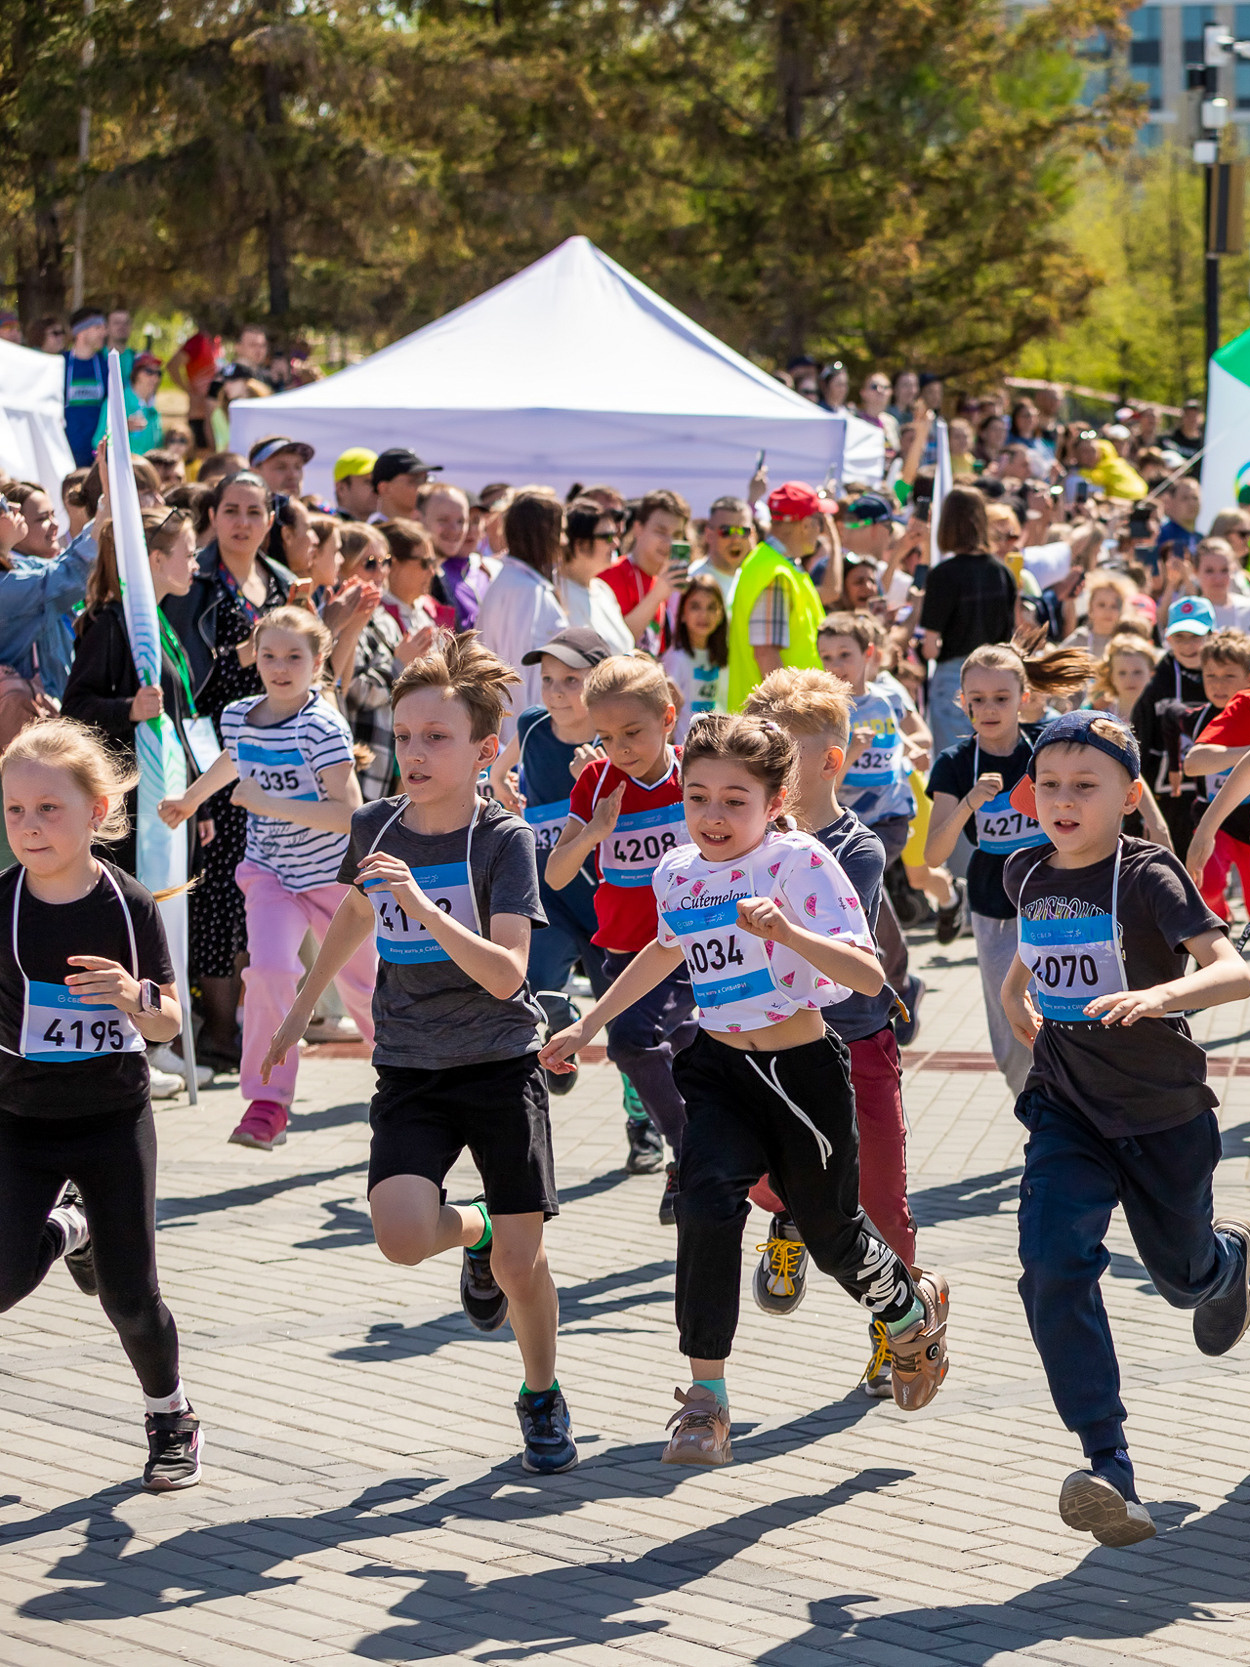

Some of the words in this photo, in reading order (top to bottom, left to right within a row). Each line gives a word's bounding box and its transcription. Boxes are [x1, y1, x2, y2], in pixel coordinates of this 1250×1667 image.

[852, 752, 893, 769] 329
[250, 769, 299, 791] 335
[614, 832, 677, 863] 4208
[1031, 954, 1099, 988] 4070
[43, 1018, 124, 1051] 4195
